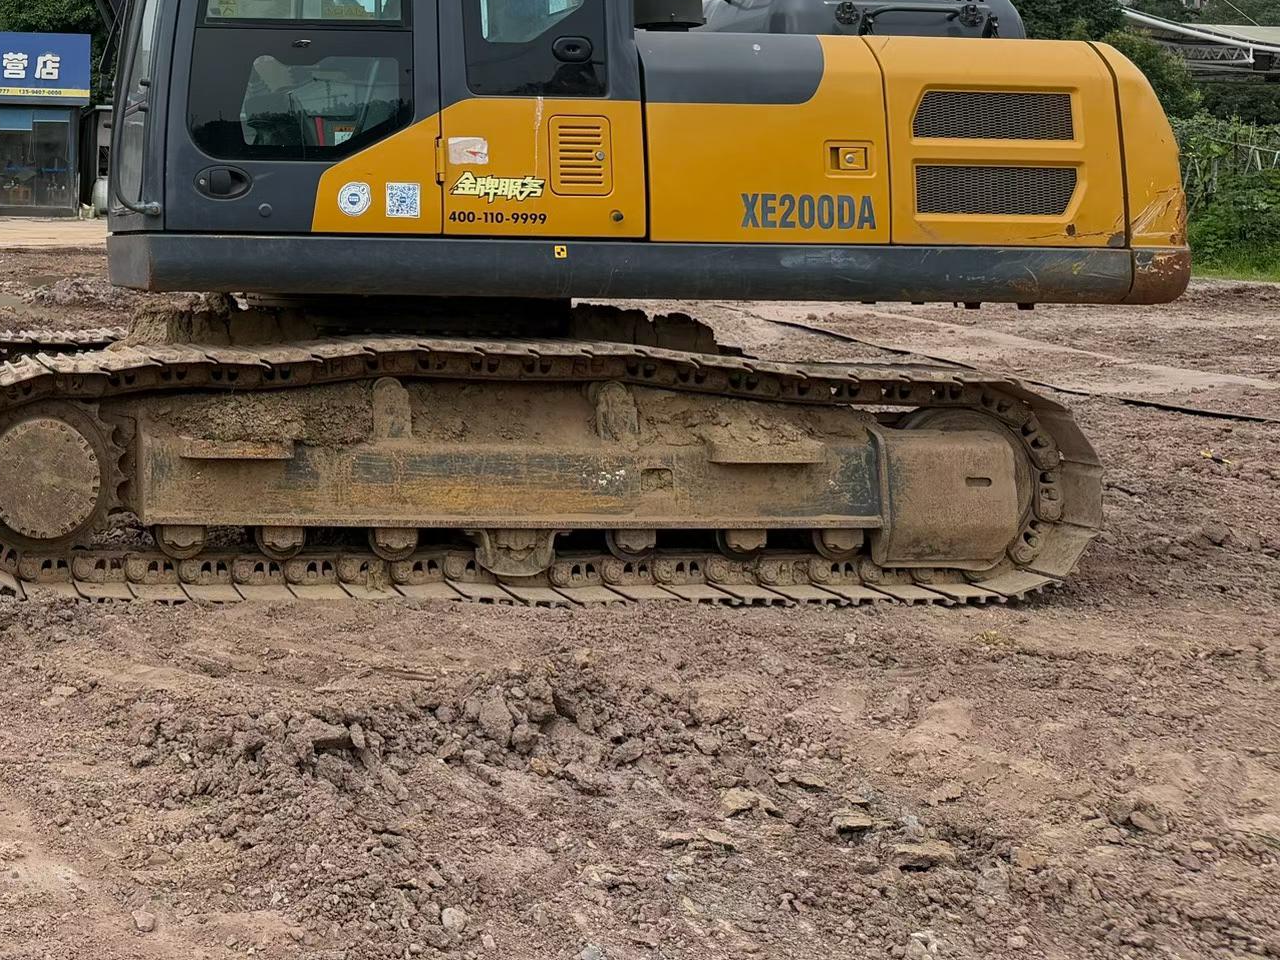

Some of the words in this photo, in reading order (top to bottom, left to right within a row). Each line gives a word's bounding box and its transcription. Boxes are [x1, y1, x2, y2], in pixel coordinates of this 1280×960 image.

[451, 171, 546, 203] 金牌服务
[449, 211, 547, 226] 400-110-9999
[741, 193, 877, 230] XE200DA
